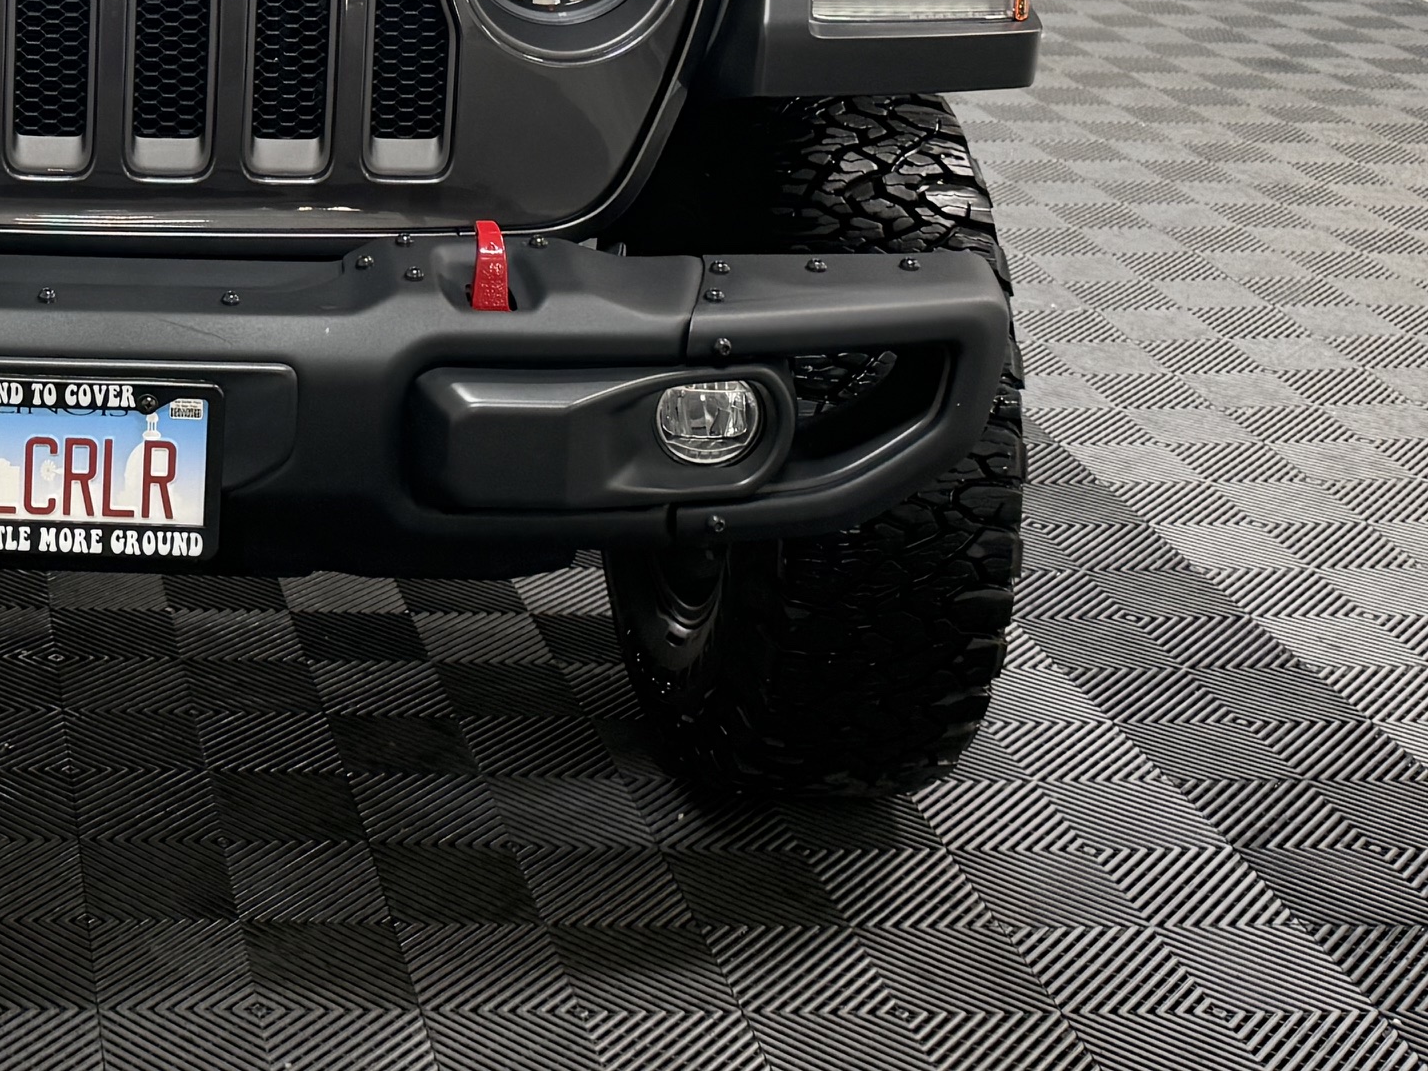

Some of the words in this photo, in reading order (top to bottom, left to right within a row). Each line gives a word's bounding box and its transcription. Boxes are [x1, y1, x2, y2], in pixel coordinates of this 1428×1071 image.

[31, 383, 57, 406] TO
[65, 384, 136, 408] COVER
[39, 527, 103, 554] MORE
[110, 530, 203, 557] GROUND
